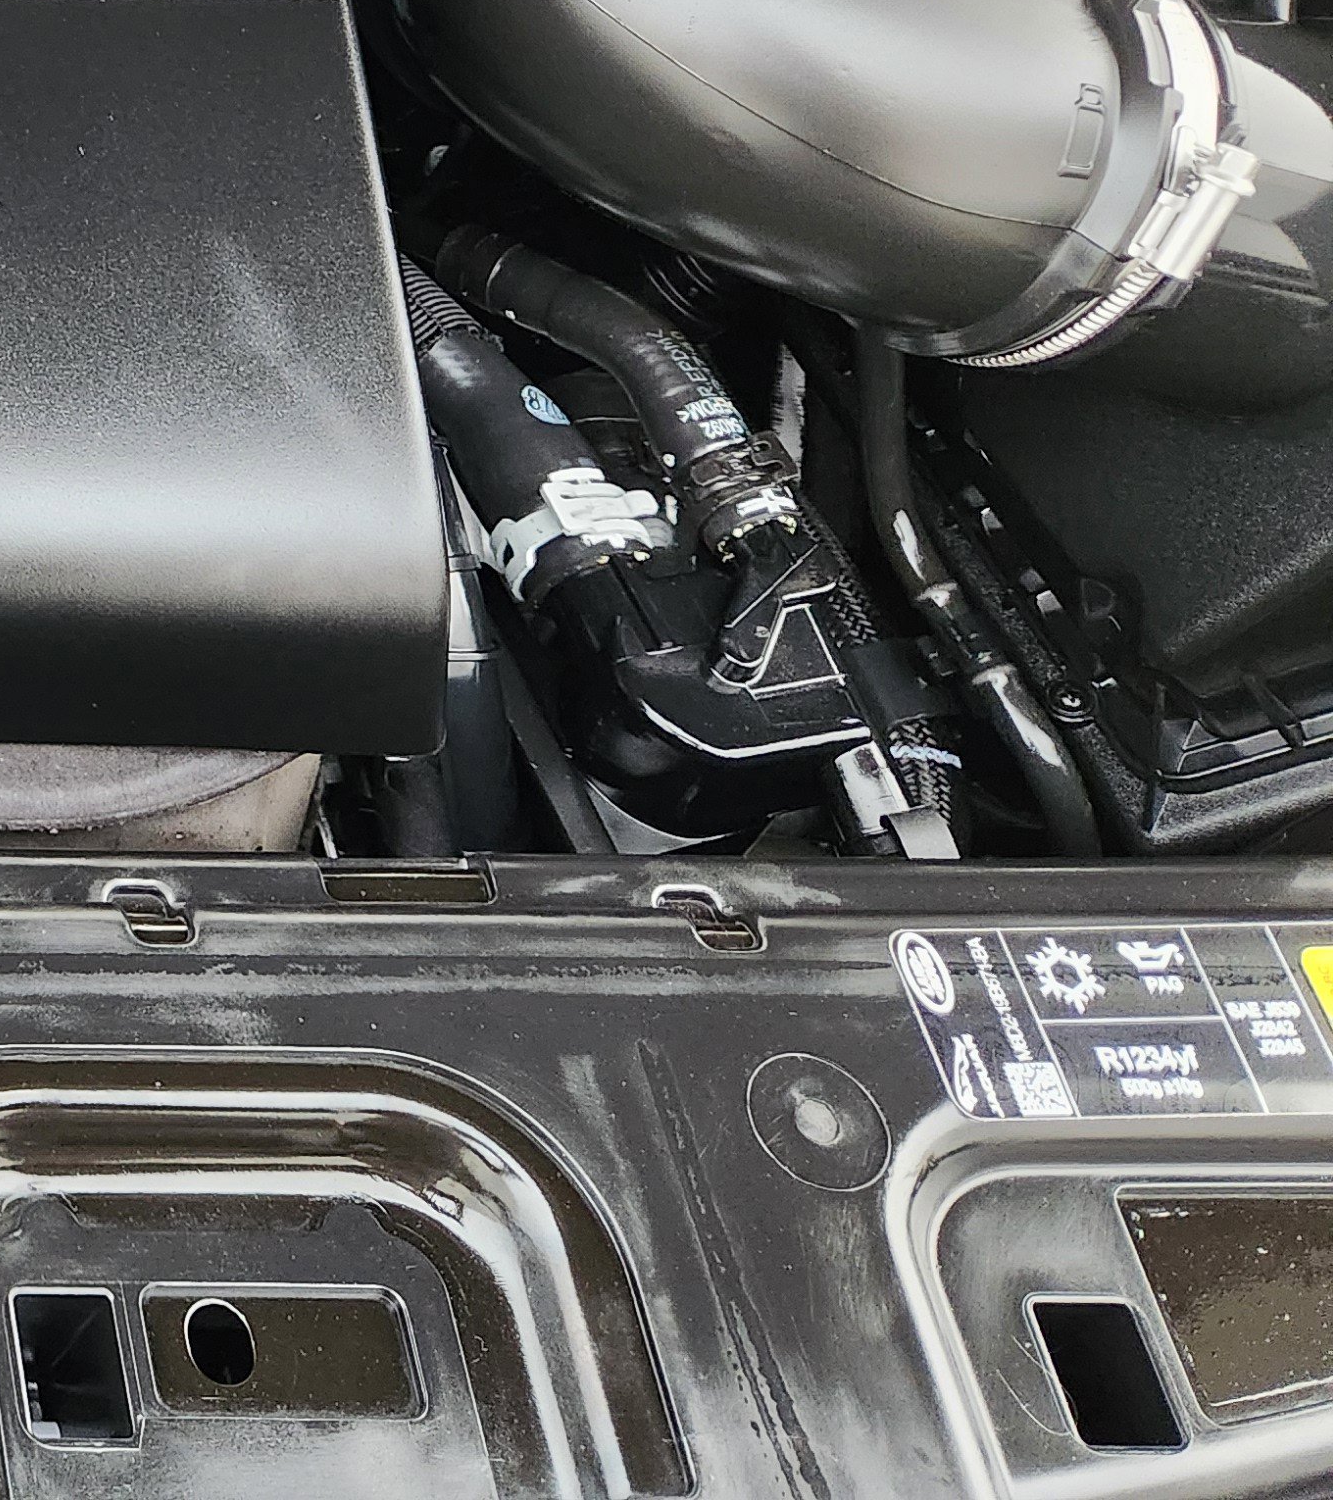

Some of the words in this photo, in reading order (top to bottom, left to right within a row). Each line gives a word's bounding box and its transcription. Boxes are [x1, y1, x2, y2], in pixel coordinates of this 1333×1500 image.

[1144, 976, 1186, 996] PAG
[1223, 1001, 1263, 1019] SAE
[1094, 1045, 1200, 1076] R1234yf
